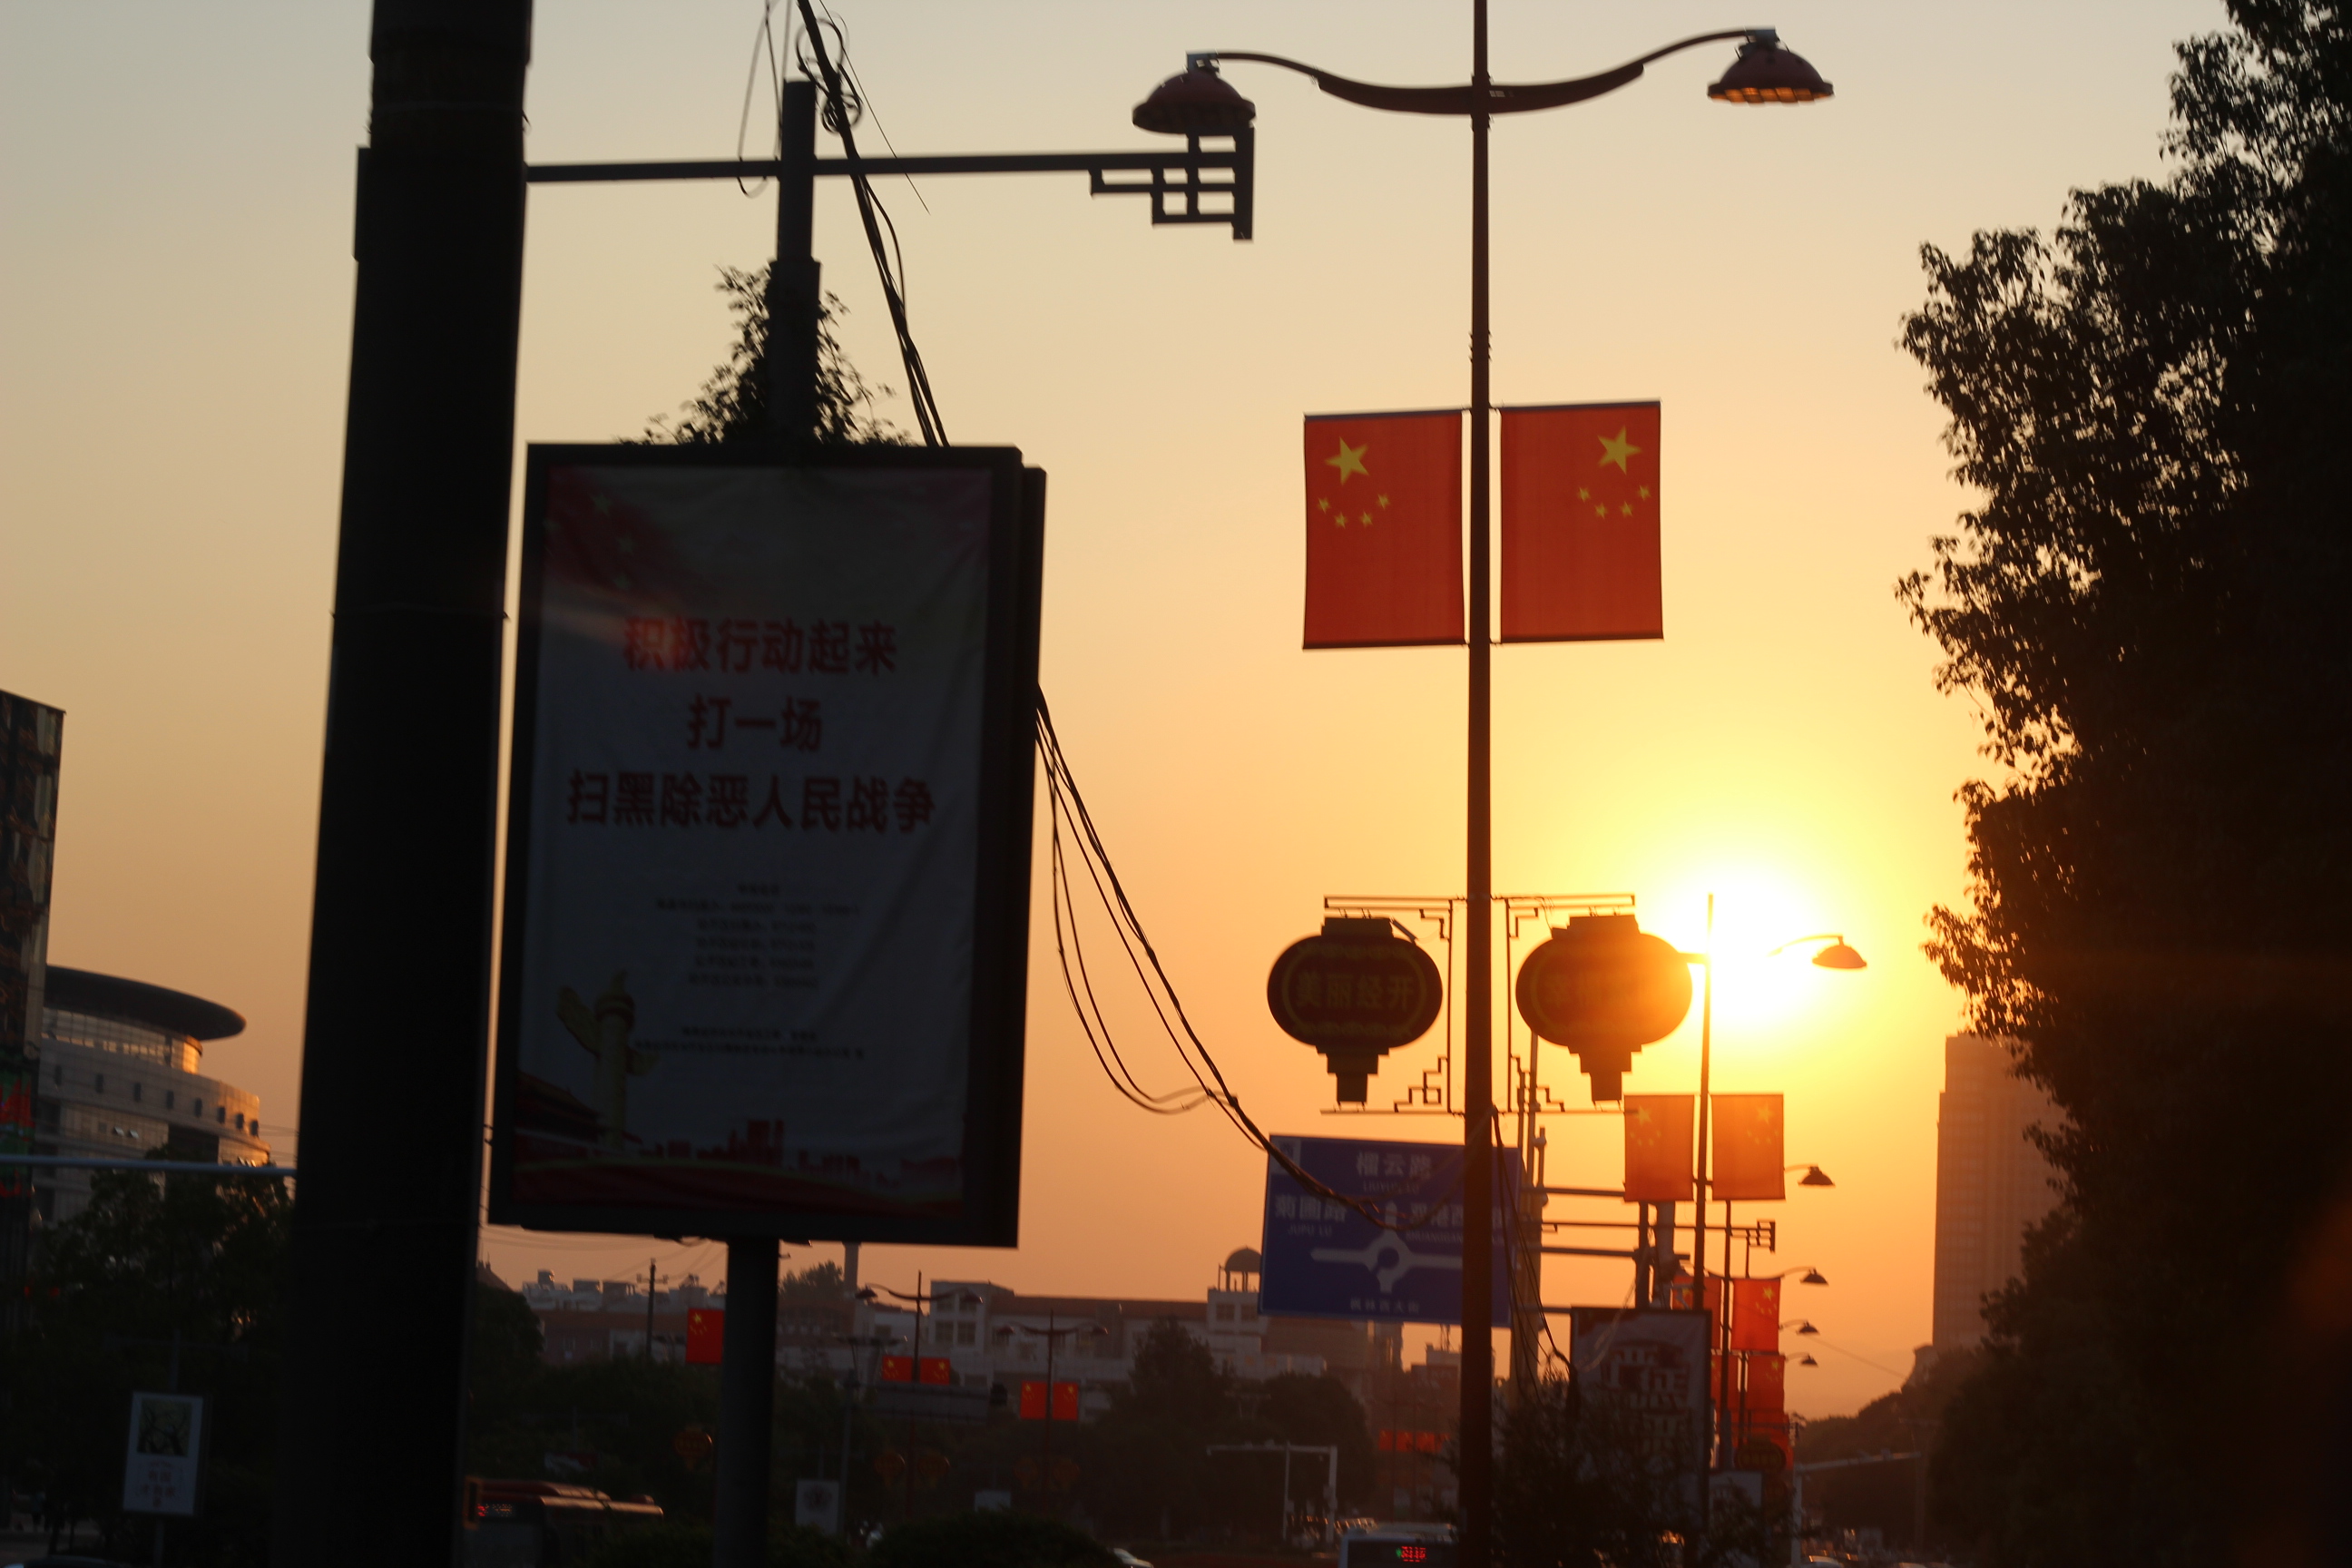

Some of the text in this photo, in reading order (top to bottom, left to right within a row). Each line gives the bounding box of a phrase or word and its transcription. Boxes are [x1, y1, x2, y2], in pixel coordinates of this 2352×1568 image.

[623, 617, 897, 676] 积极行动起来
[687, 694, 823, 753] 打一场
[567, 769, 936, 833] 扫黑除恶人民战争
[1297, 970, 1414, 1012] 美丽经开
